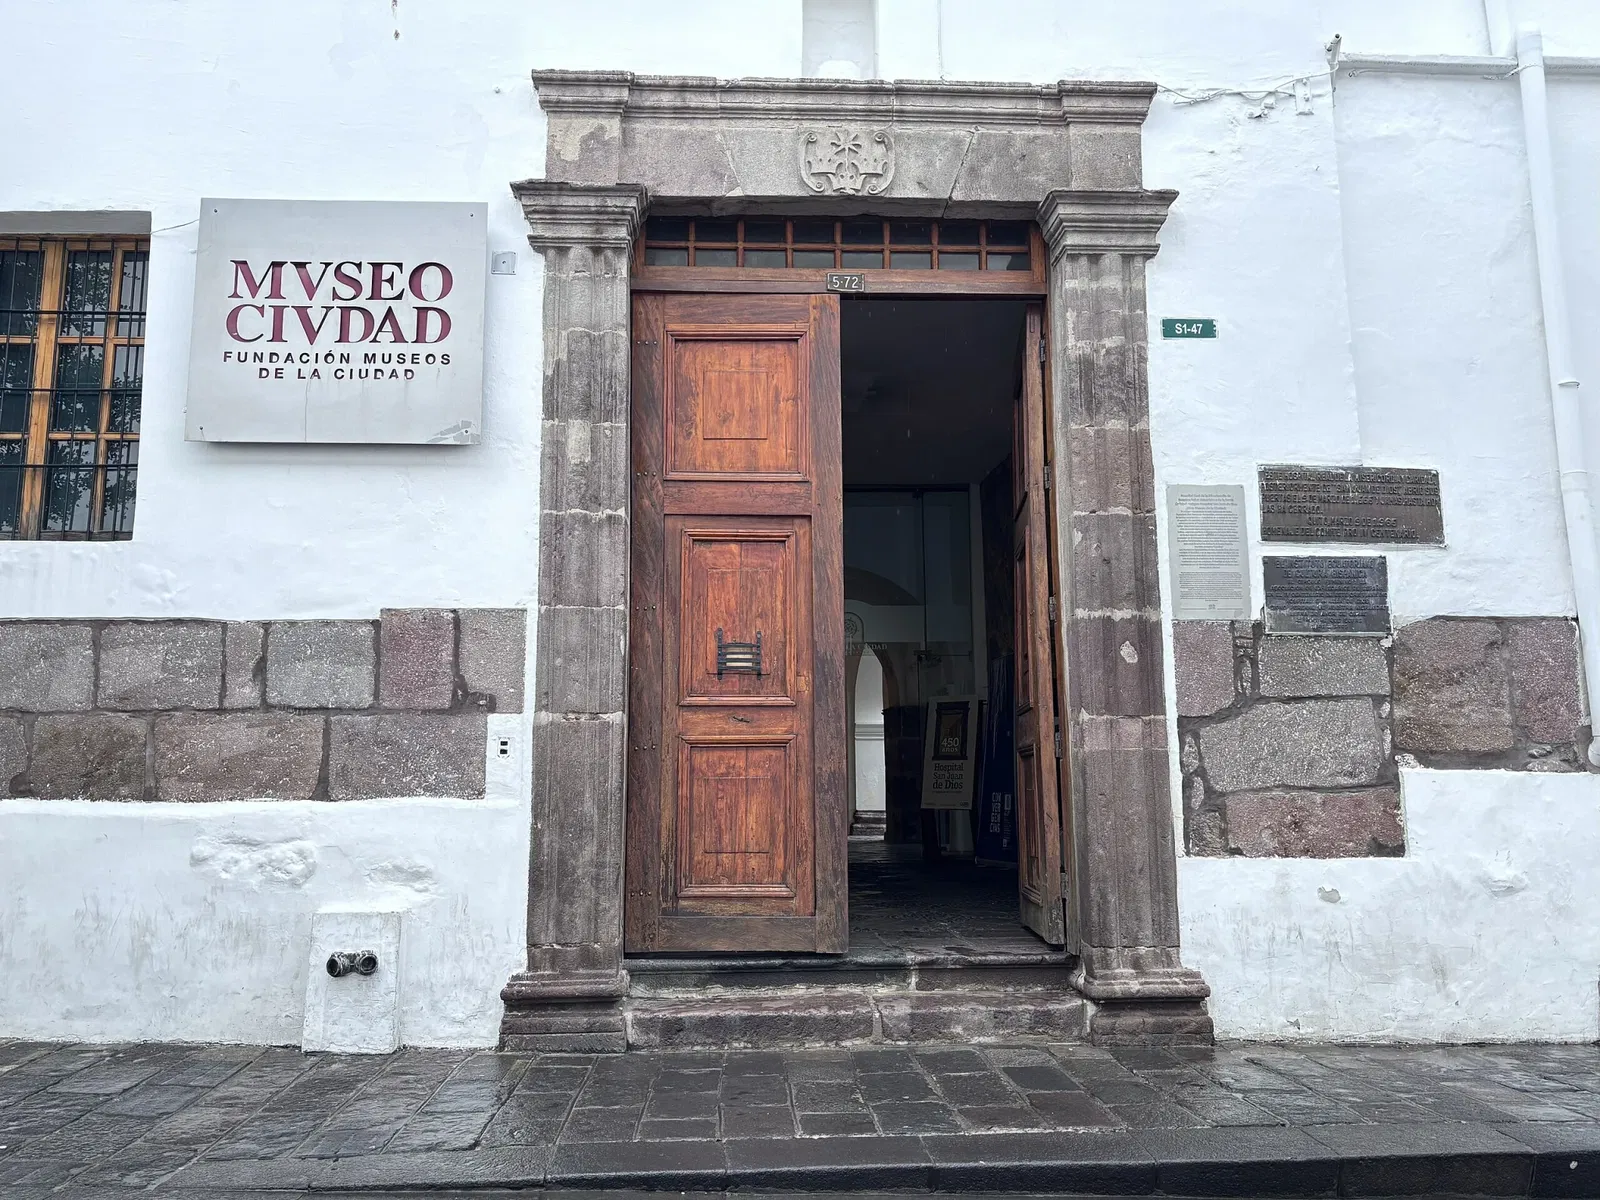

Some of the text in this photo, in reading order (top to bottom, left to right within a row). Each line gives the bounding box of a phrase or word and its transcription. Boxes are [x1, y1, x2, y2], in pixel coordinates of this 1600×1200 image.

[227, 259, 454, 302] MVSEO
[226, 303, 453, 346] CIVDAD
[1175, 323, 1203, 335] S1-47
[223, 350, 452, 365] FUNDACIÓN MUSEOS
[258, 367, 416, 381] DE LA CIUDAD
[941, 737, 960, 747] 450
[934, 762, 964, 772] Hospital
[946, 772, 963, 780] Juan
[932, 779, 963, 789] de Dios
